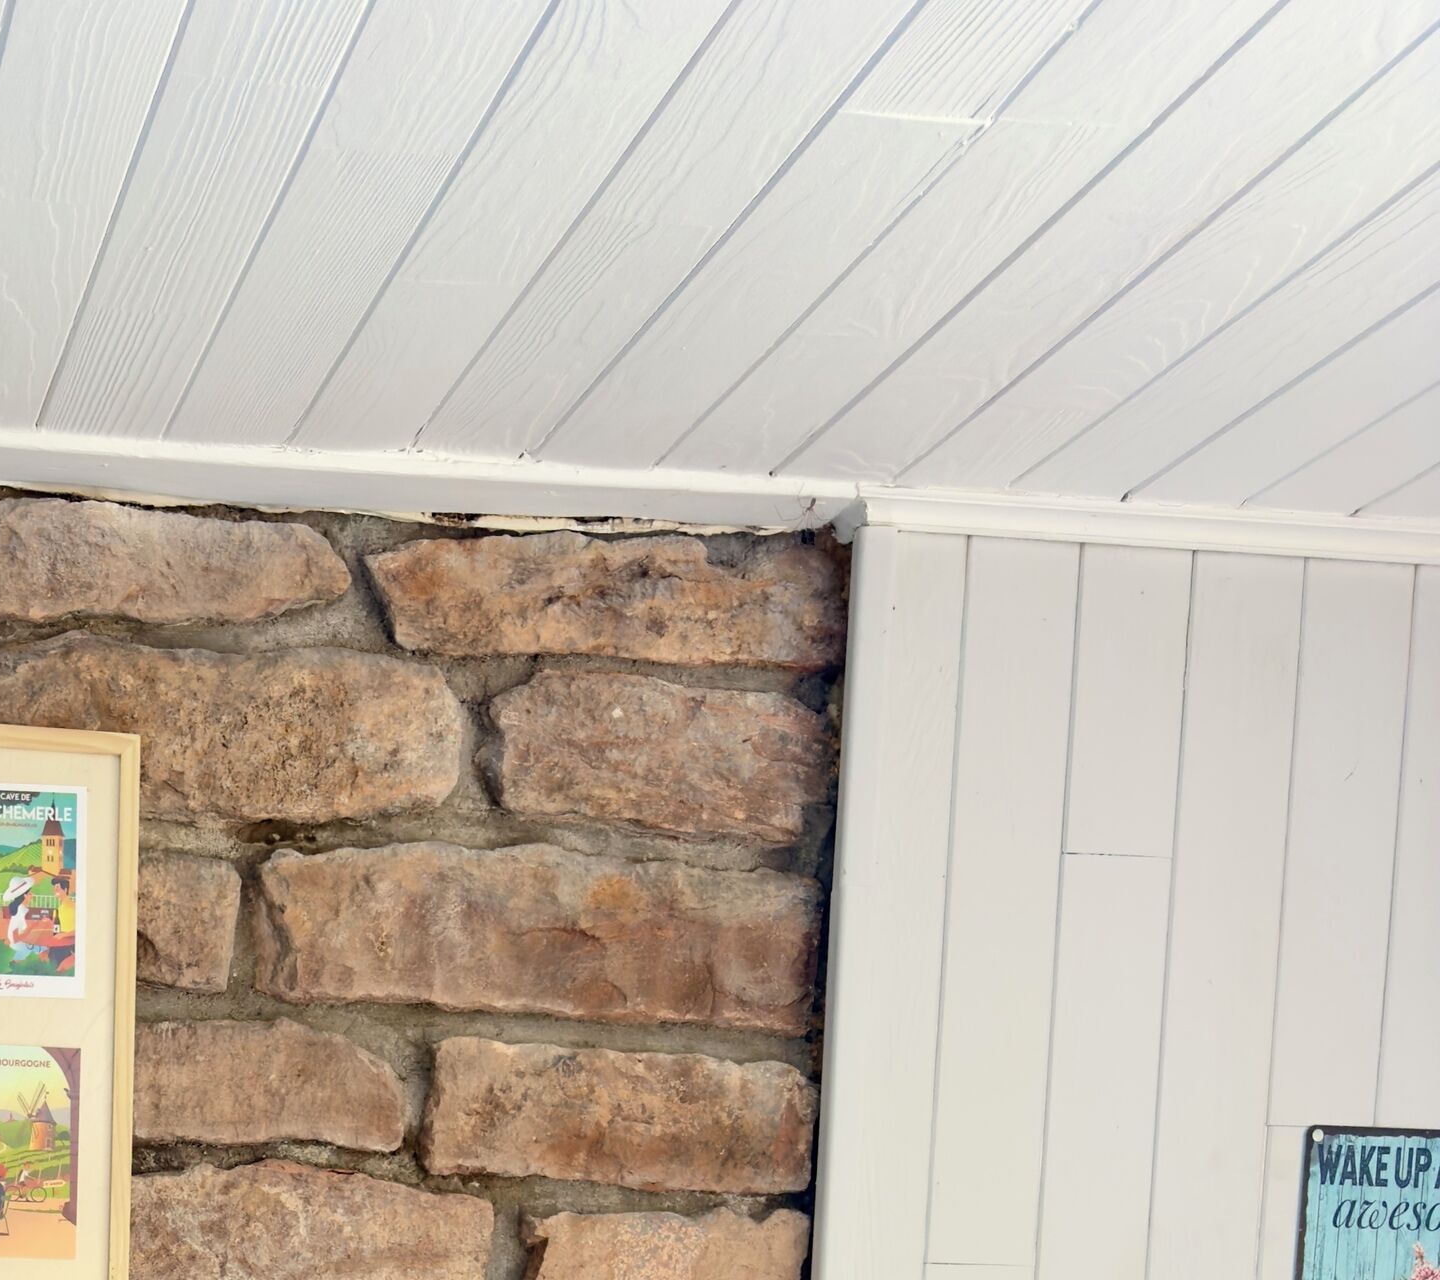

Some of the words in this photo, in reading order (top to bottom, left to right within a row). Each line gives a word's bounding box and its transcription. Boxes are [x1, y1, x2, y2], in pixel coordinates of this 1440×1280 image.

[0, 792, 19, 801] CAVE
[21, 793, 31, 801] DE
[1318, 1143, 1391, 1187] WAKE
[1394, 1147, 1433, 1188] UP
